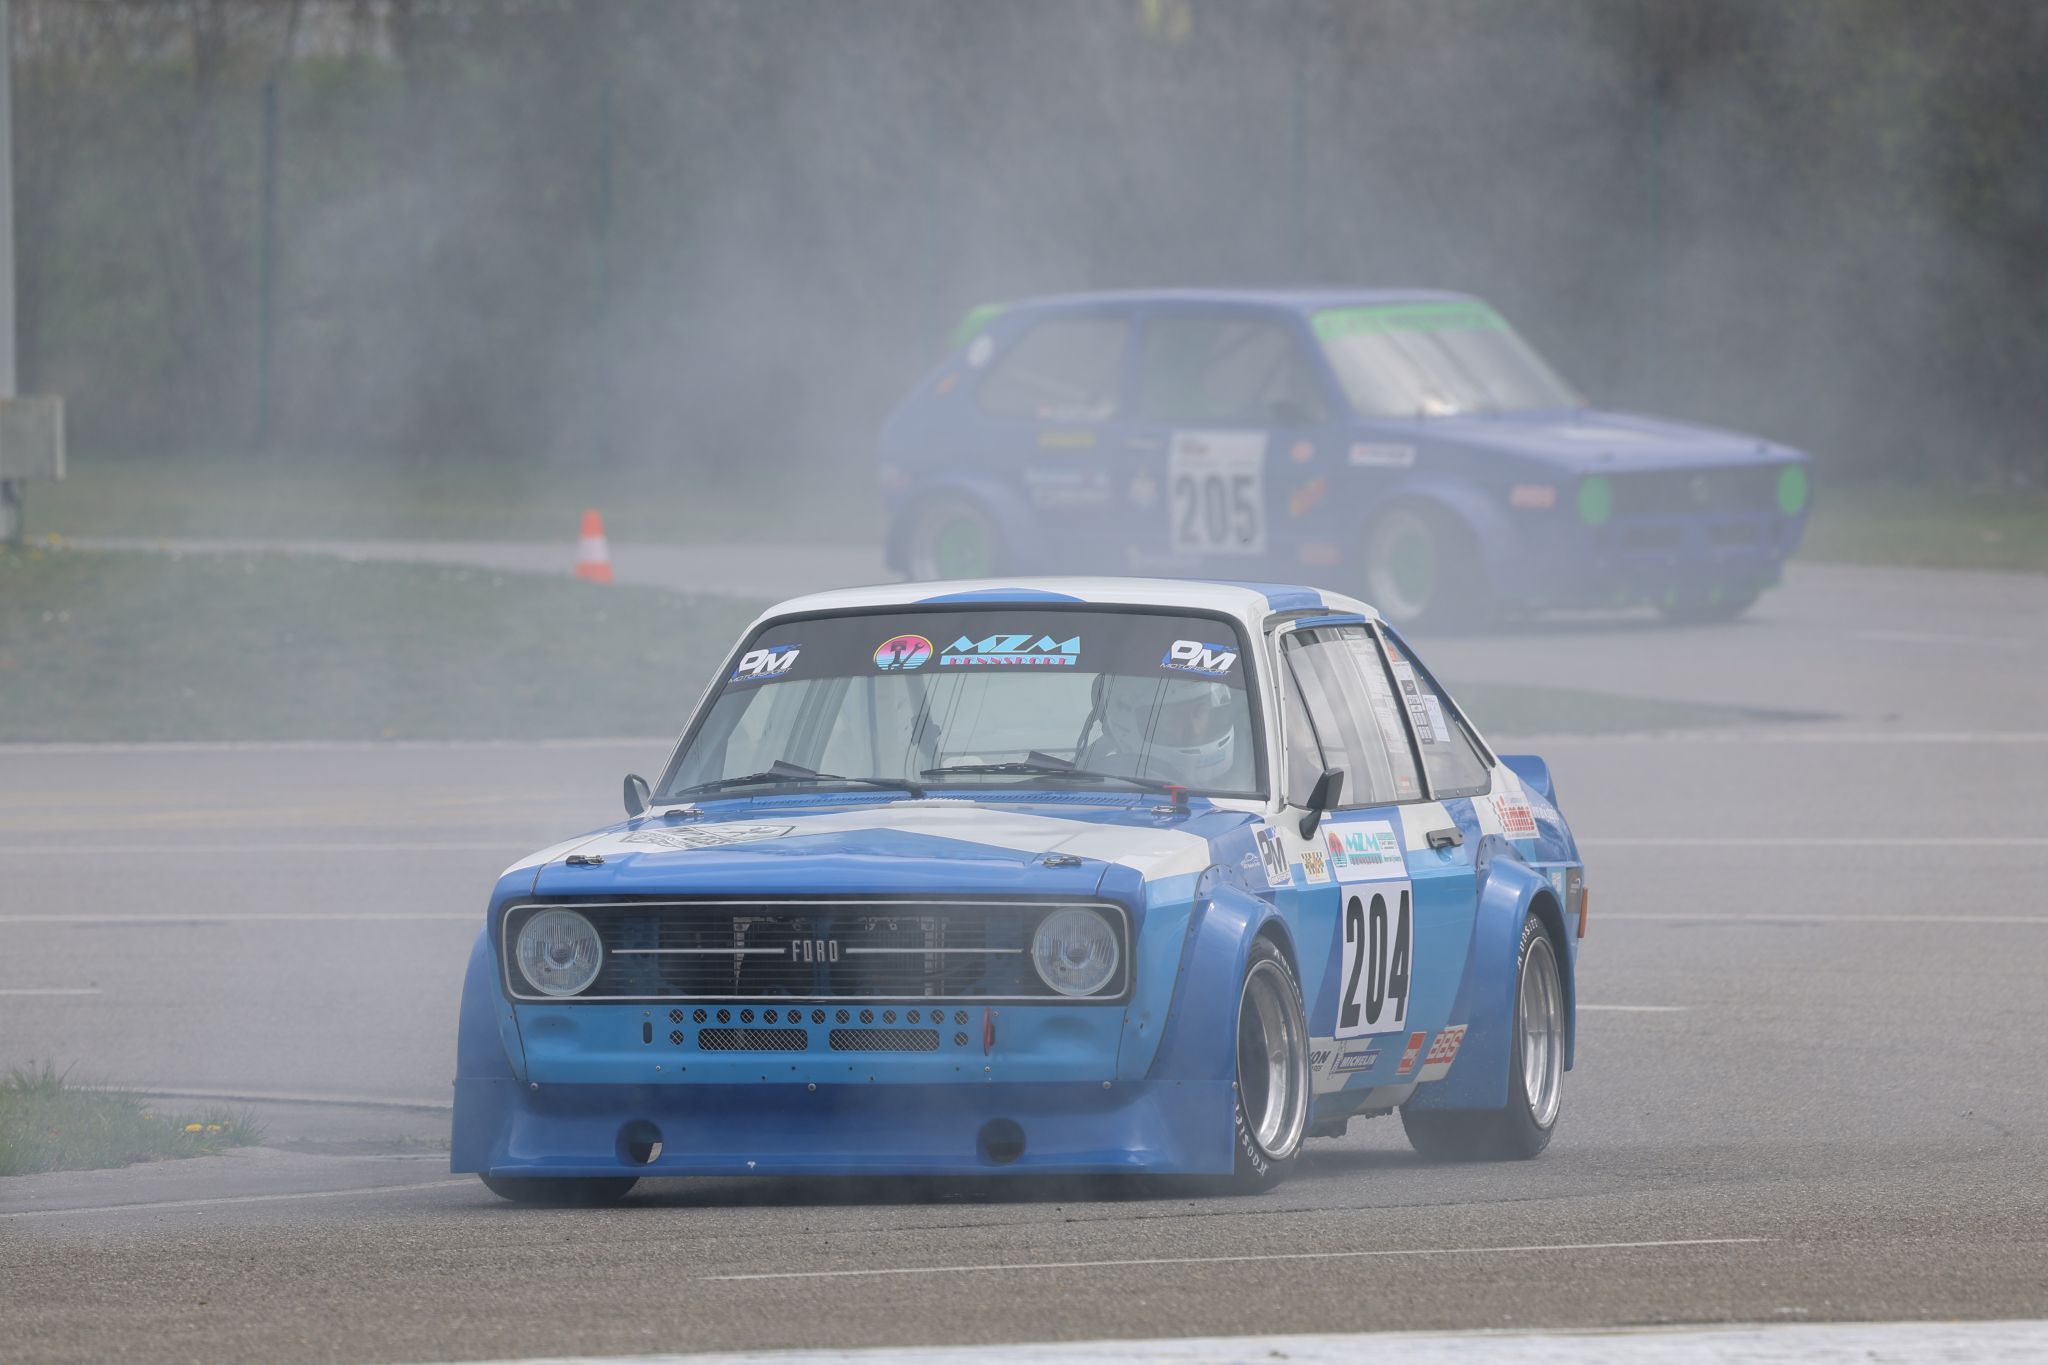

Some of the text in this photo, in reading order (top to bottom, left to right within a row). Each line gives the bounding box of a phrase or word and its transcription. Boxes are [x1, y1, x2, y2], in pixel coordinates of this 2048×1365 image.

[1176, 474, 1257, 545] 205
[941, 634, 1080, 654] MZM
[1345, 832, 1381, 851] MZM
[792, 940, 838, 962] FORD
[1340, 890, 1409, 1029] 204
[1427, 1030, 1465, 1058] BBS
[1340, 1055, 1377, 1068] MICHELIN
